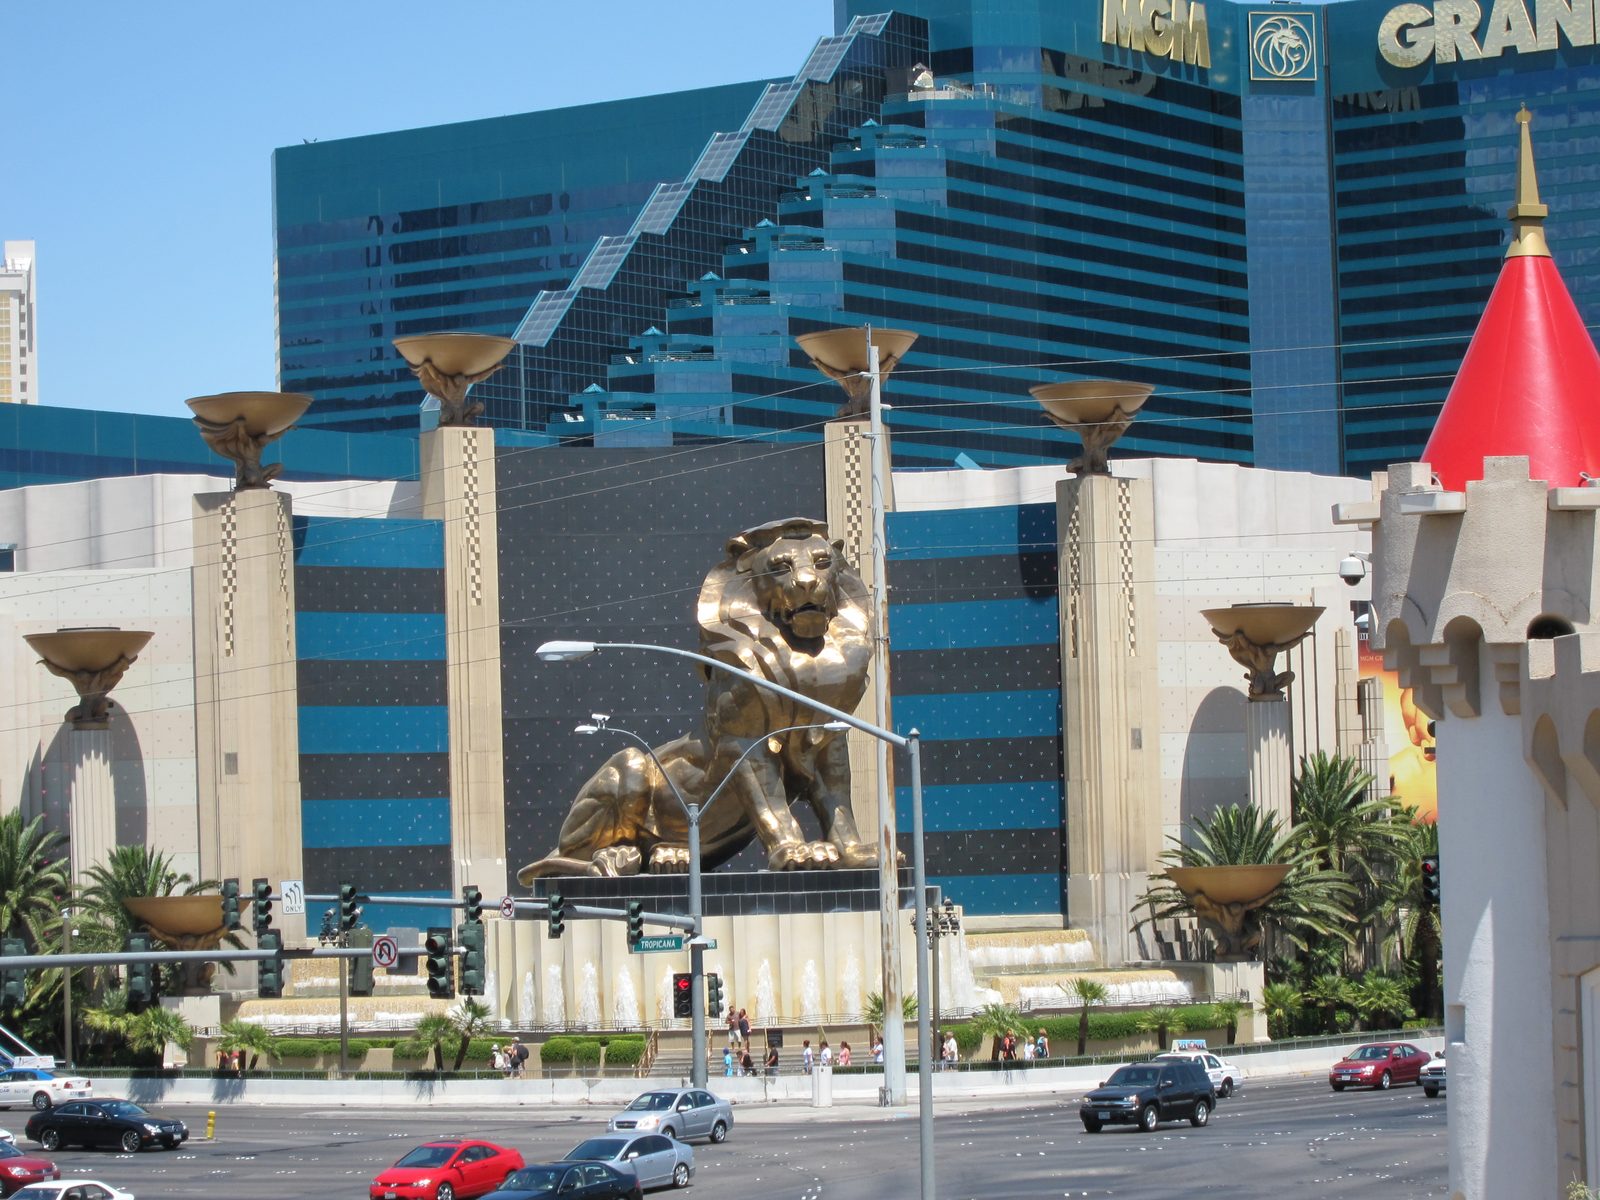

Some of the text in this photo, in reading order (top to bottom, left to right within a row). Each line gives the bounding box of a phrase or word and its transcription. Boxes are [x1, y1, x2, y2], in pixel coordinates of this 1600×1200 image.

[1101, 0, 1212, 68] MGM
[1378, 0, 1600, 68] GRAN
[641, 939, 676, 949] TROPICANA
